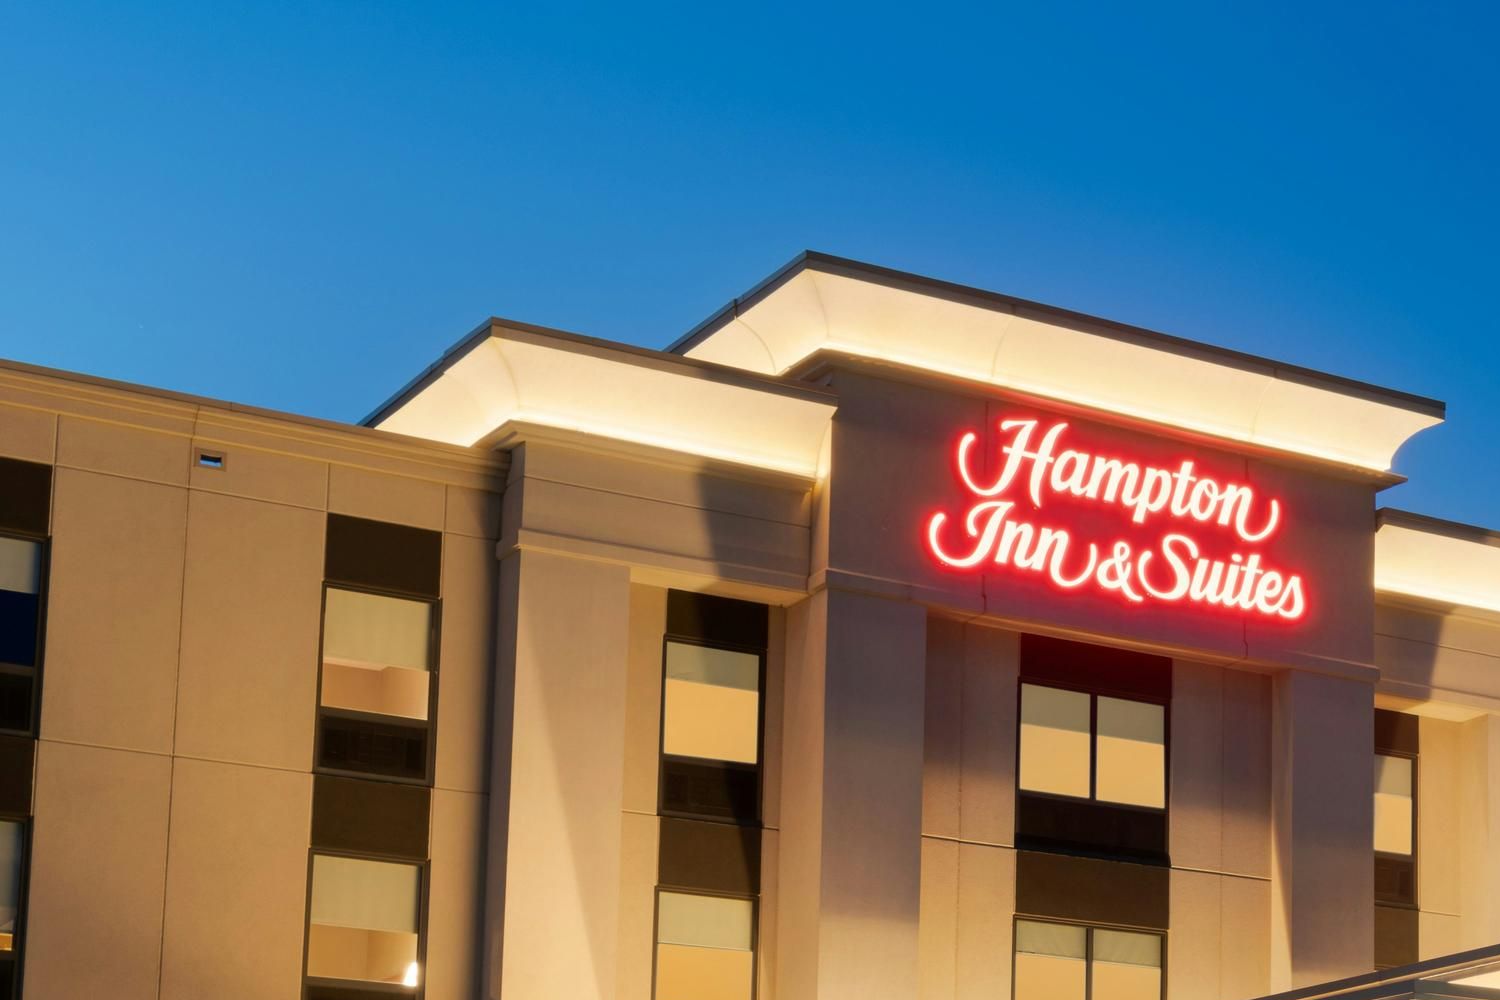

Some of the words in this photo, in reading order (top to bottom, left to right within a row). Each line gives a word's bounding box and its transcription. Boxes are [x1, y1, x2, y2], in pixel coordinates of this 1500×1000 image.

[957, 419, 1279, 542] Hampton
[928, 500, 1098, 588] Inn
[1096, 541, 1144, 602] &
[1138, 533, 1304, 619] Suites
